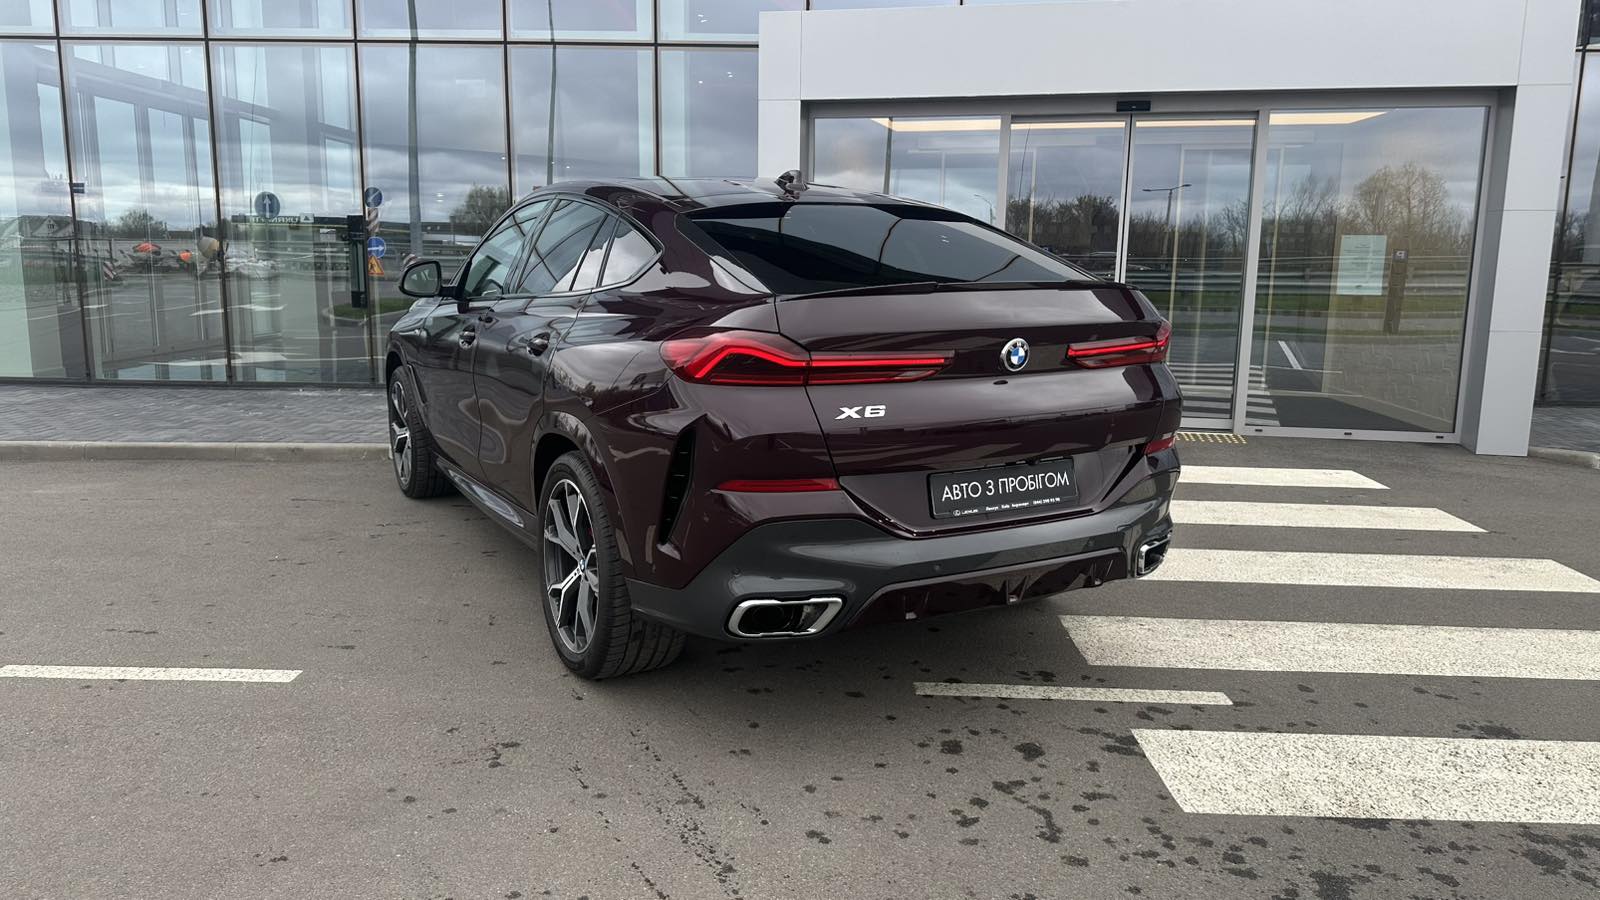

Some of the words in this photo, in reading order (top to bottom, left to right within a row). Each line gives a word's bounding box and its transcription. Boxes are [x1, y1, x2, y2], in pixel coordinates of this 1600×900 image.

[834, 404, 886, 420] X6
[942, 481, 982, 502] АВТО
[985, 479, 995, 496] З
[998, 471, 1070, 494] ПРОБІГОМ
